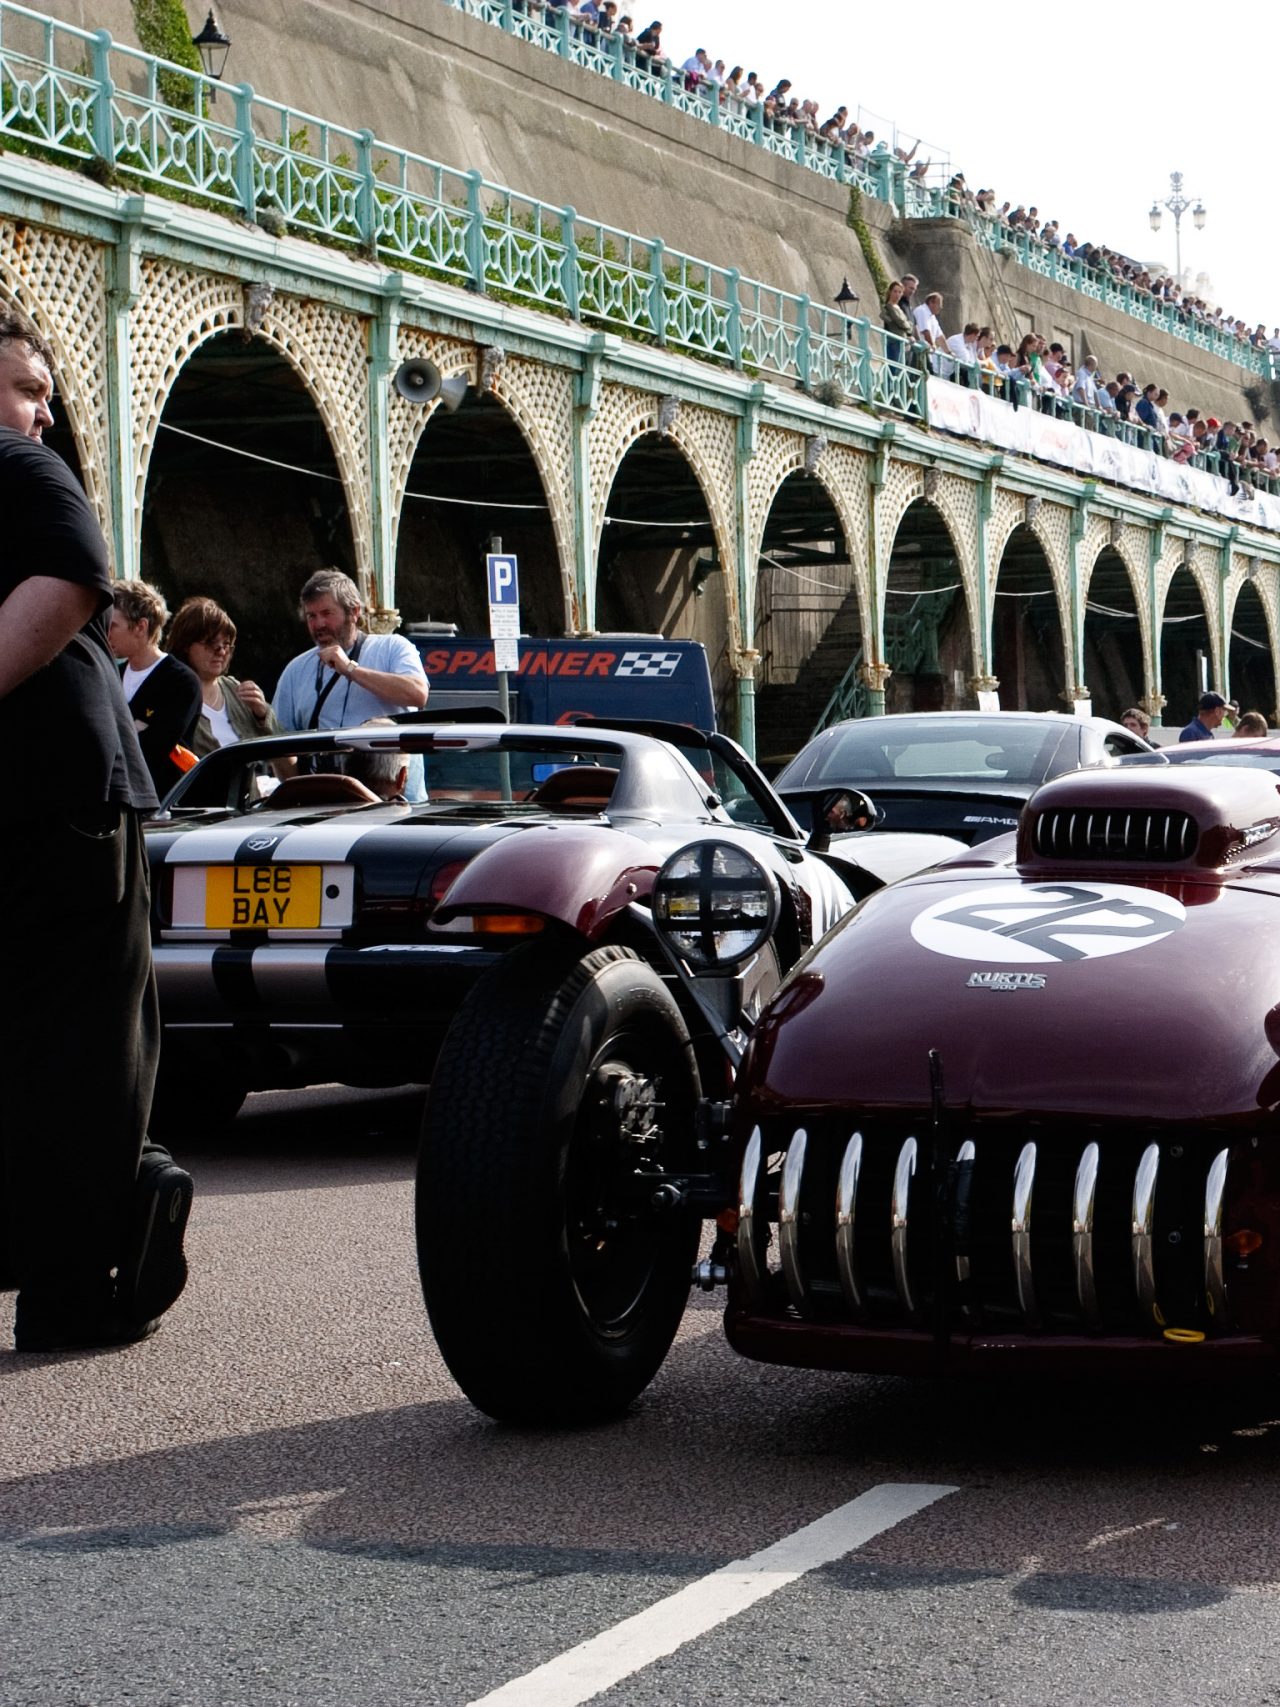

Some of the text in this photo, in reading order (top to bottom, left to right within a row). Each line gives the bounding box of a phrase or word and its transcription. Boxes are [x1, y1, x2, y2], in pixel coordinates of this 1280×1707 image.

[494, 561, 512, 602] P
[979, 816, 1018, 826] AMG
[232, 897, 291, 925] BAY
[968, 972, 1047, 987] KURTIS
